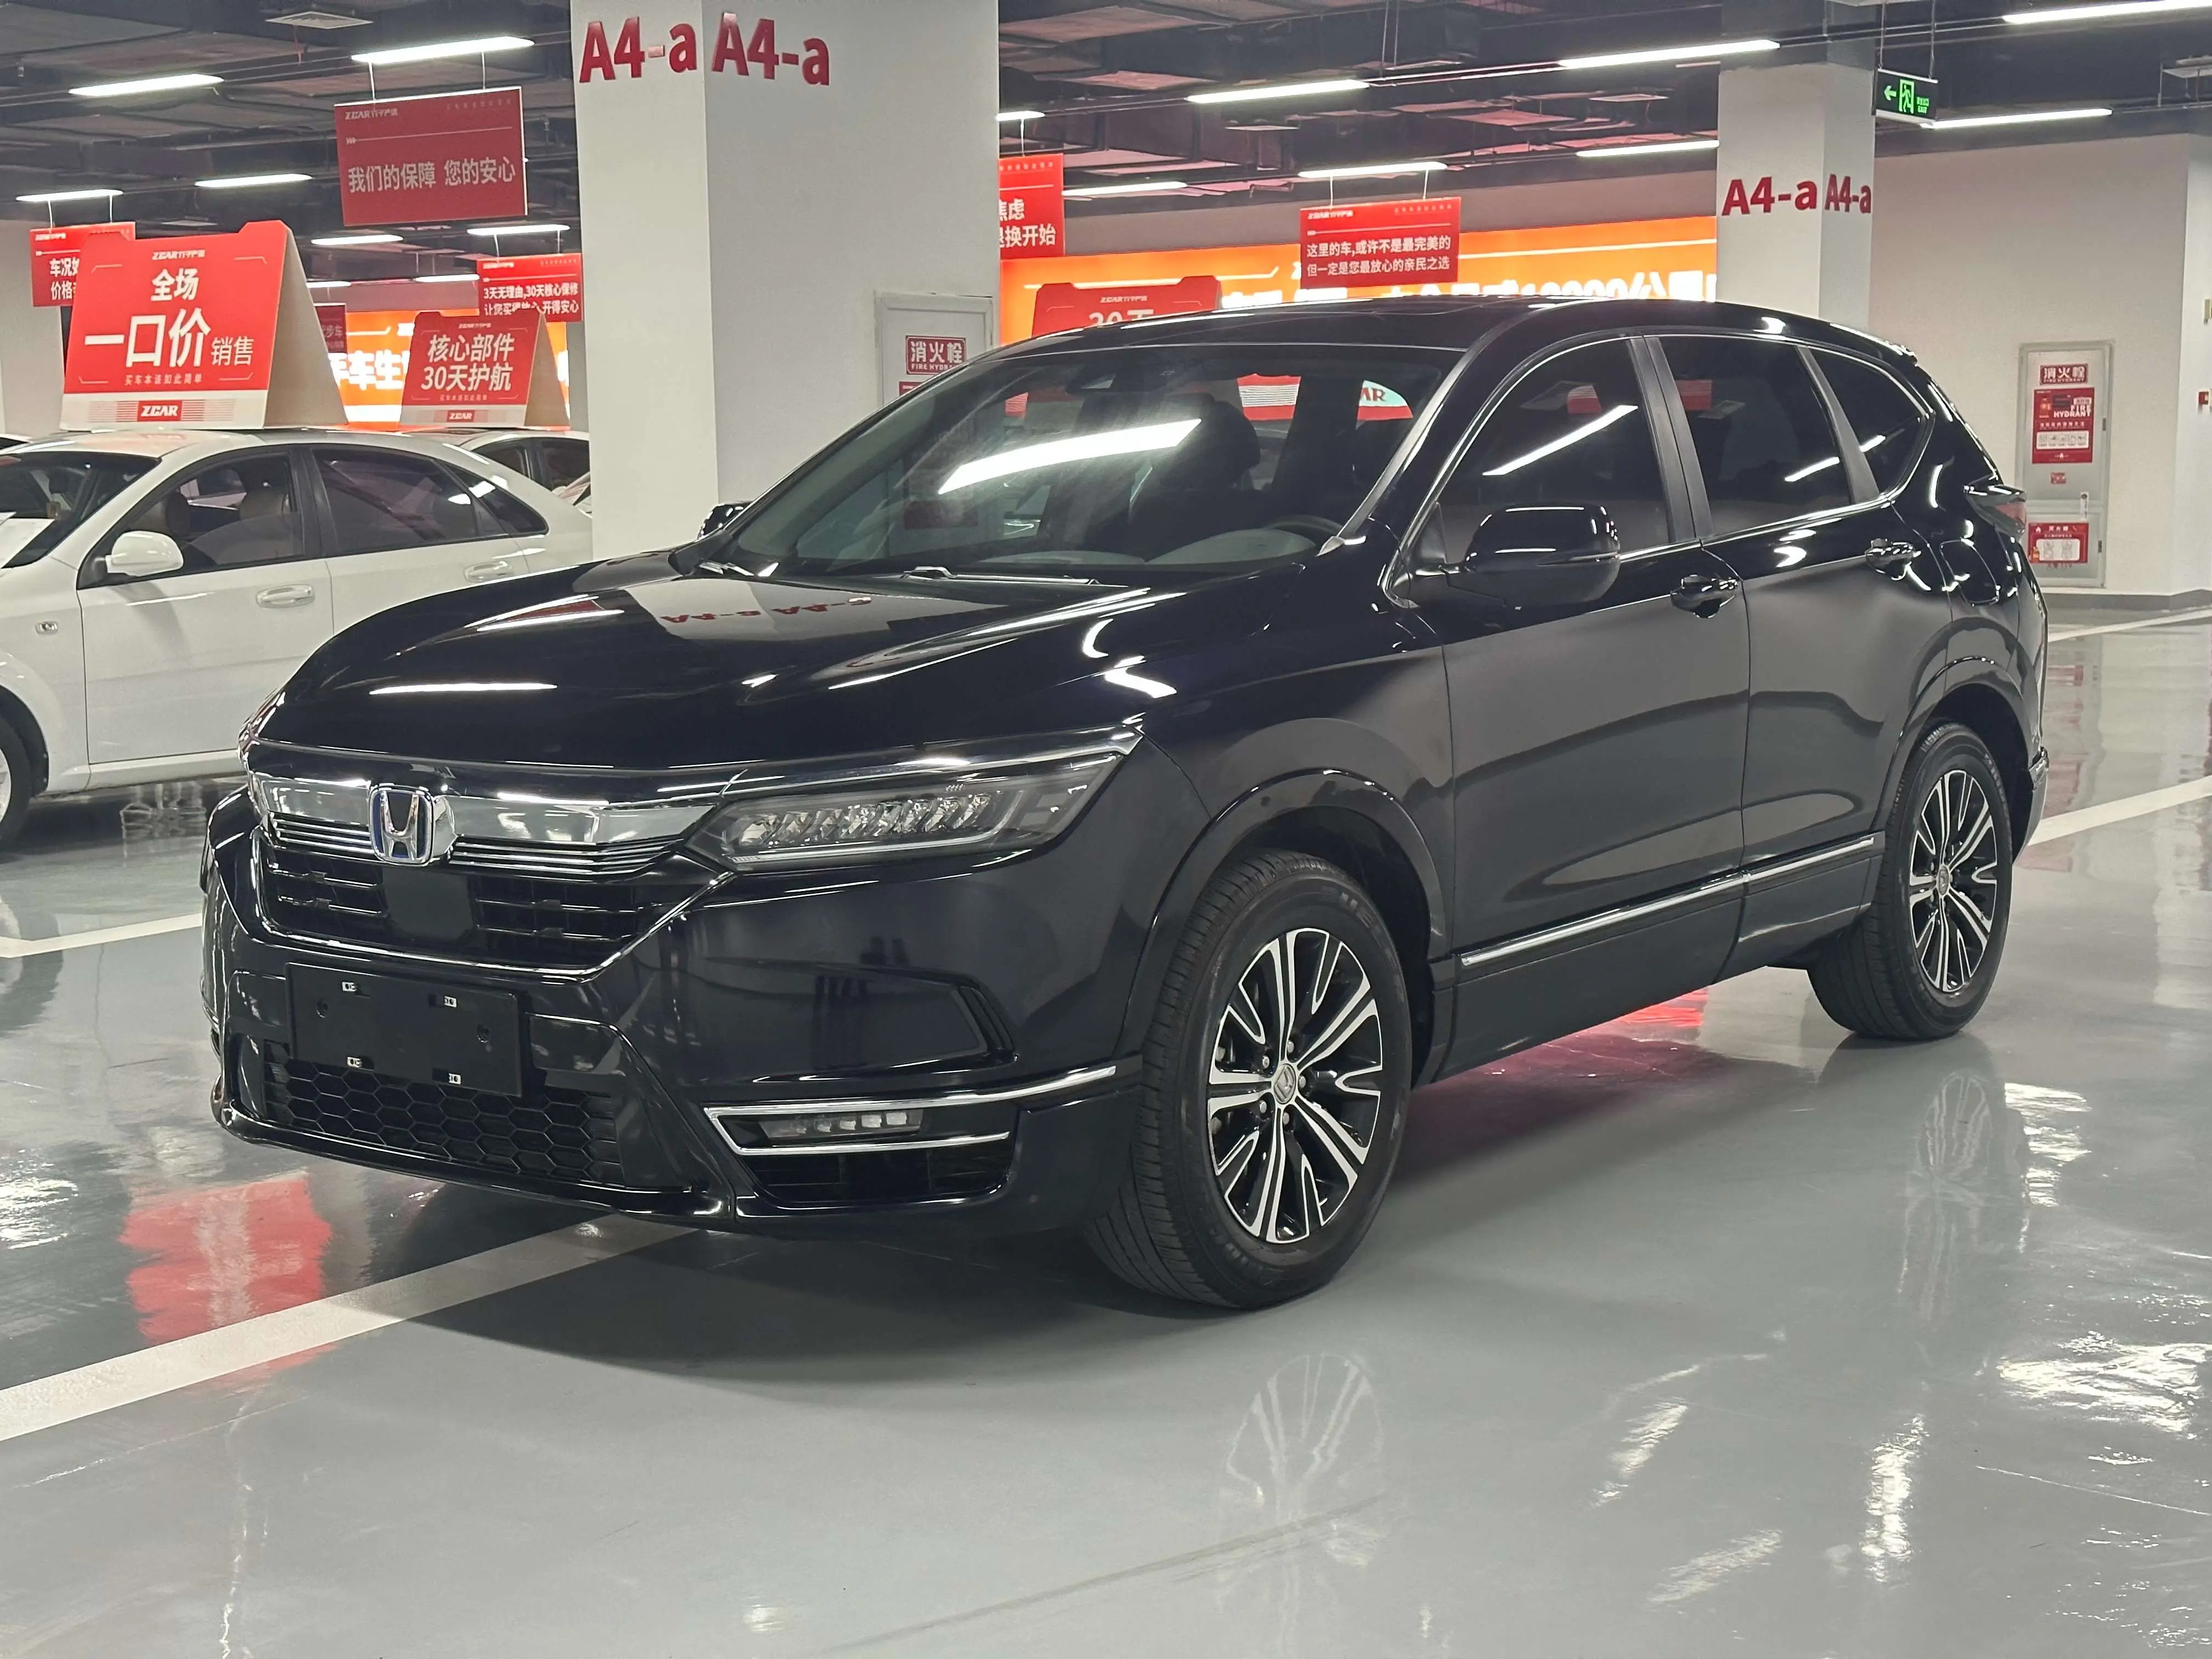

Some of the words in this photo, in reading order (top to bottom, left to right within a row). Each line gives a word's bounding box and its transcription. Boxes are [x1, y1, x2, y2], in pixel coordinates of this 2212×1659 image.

[579, 16, 697, 83] A4-a
[712, 12, 830, 86] A4-a
[347, 161, 436, 194] 我们的保障
[444, 156, 516, 187] 您的安心
[1722, 175, 1817, 216] A4-a
[1825, 173, 1872, 214] A4-a
[1307, 235, 1451, 258] 这里的车,或许不是最完美的
[1307, 256, 1450, 276] 但一定是您最放心的亲民之选
[150, 268, 199, 301] 全场
[84, 307, 211, 368] 一口价
[211, 336, 255, 366] 销售
[427, 333, 515, 363] 核心部件
[911, 341, 962, 364] 消火栓
[421, 364, 512, 391] 30天护航
[2044, 366, 2085, 379] 消火栓
[141, 405, 178, 417] ZCAR
